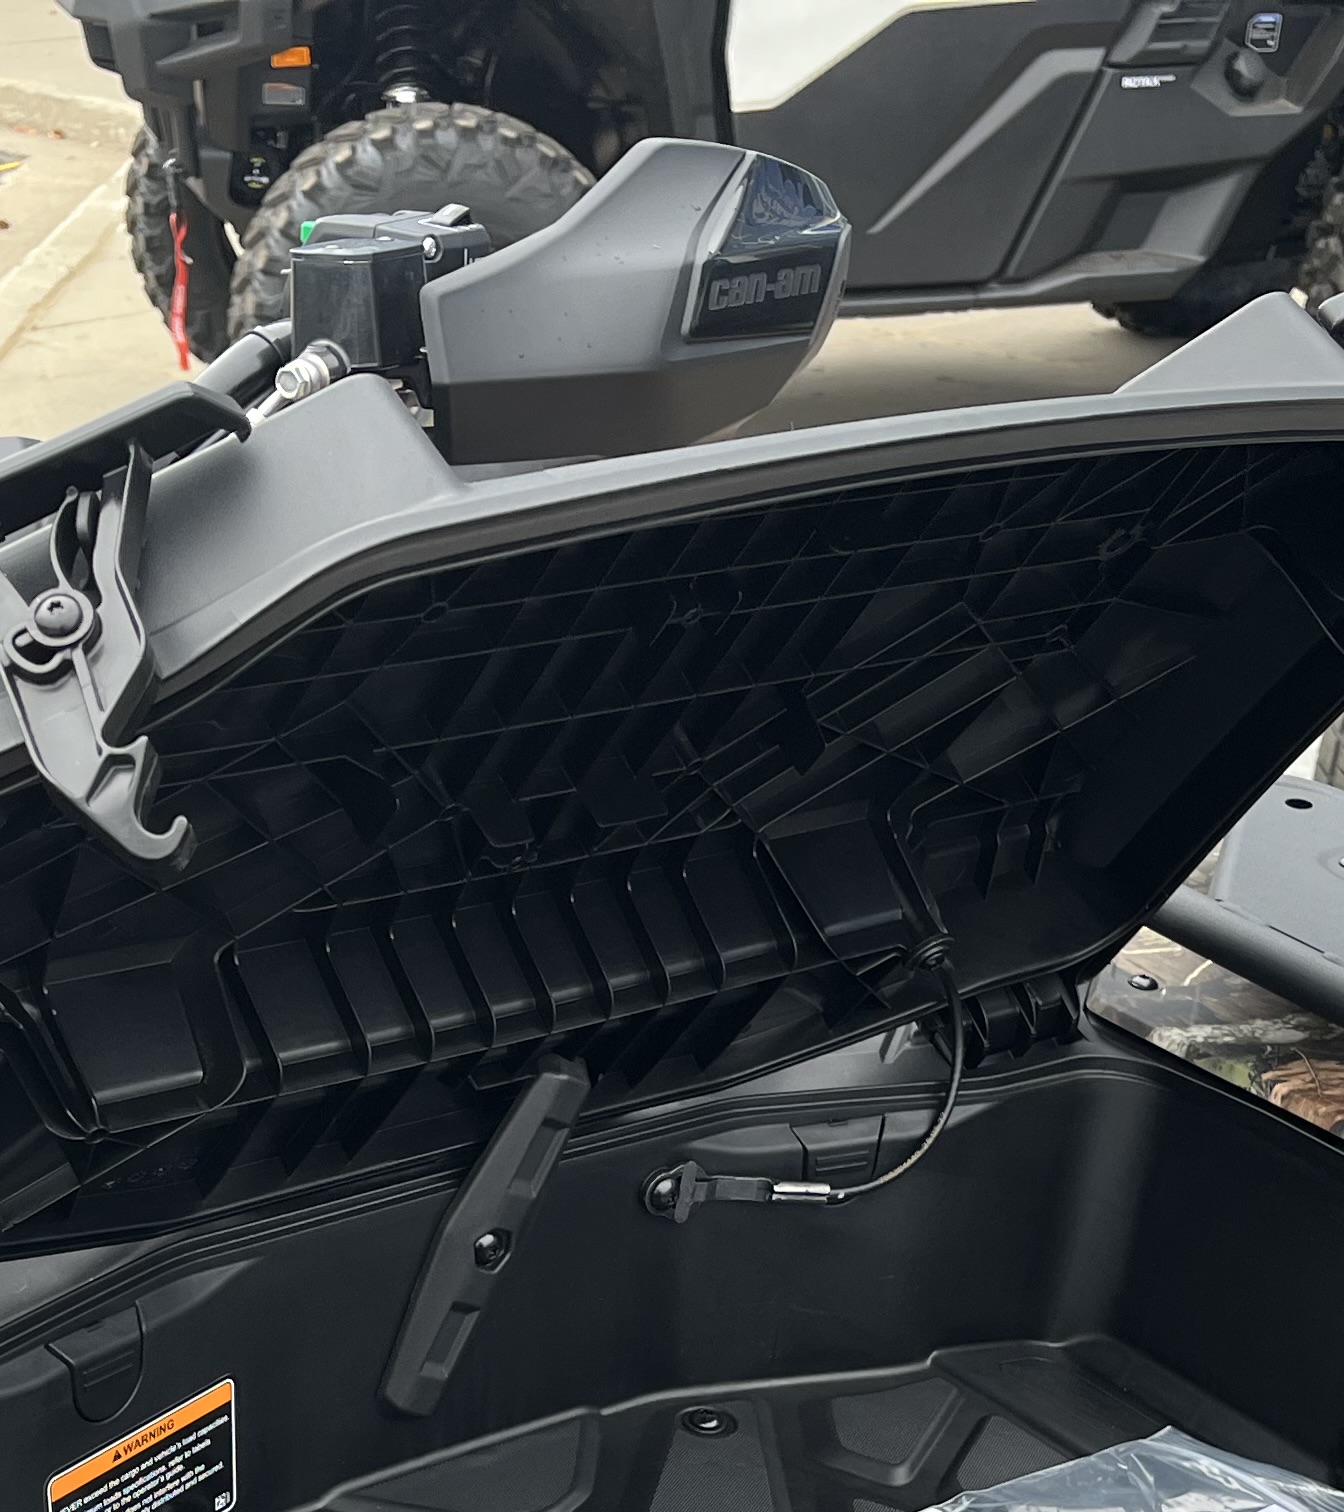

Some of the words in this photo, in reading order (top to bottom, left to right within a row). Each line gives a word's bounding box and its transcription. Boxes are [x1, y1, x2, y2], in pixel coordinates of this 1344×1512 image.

[708, 263, 822, 311] can-am
[123, 1418, 174, 1456] WARNING
[168, 1451, 183, 1468] refer
[184, 1448, 191, 1459] to
[83, 1482, 108, 1504] exceed
[108, 1475, 120, 1490] the
[120, 1465, 139, 1484] cargo
[140, 1455, 153, 1471] and
[153, 1439, 181, 1463] vehicle's
[182, 1430, 196, 1447] load
[112, 1500, 120, 1511] to
[120, 1493, 131, 1506] the
[132, 1473, 164, 1501] operator's
[165, 1461, 185, 1481] guide.
[142, 1493, 152, 1506] not
[153, 1476, 179, 1499] interfere
[180, 1468, 193, 1483] with
[194, 1461, 205, 1475] the
[151, 1483, 184, 1510] distributed
[185, 1475, 197, 1489] and
[198, 1459, 224, 1482] secured.
